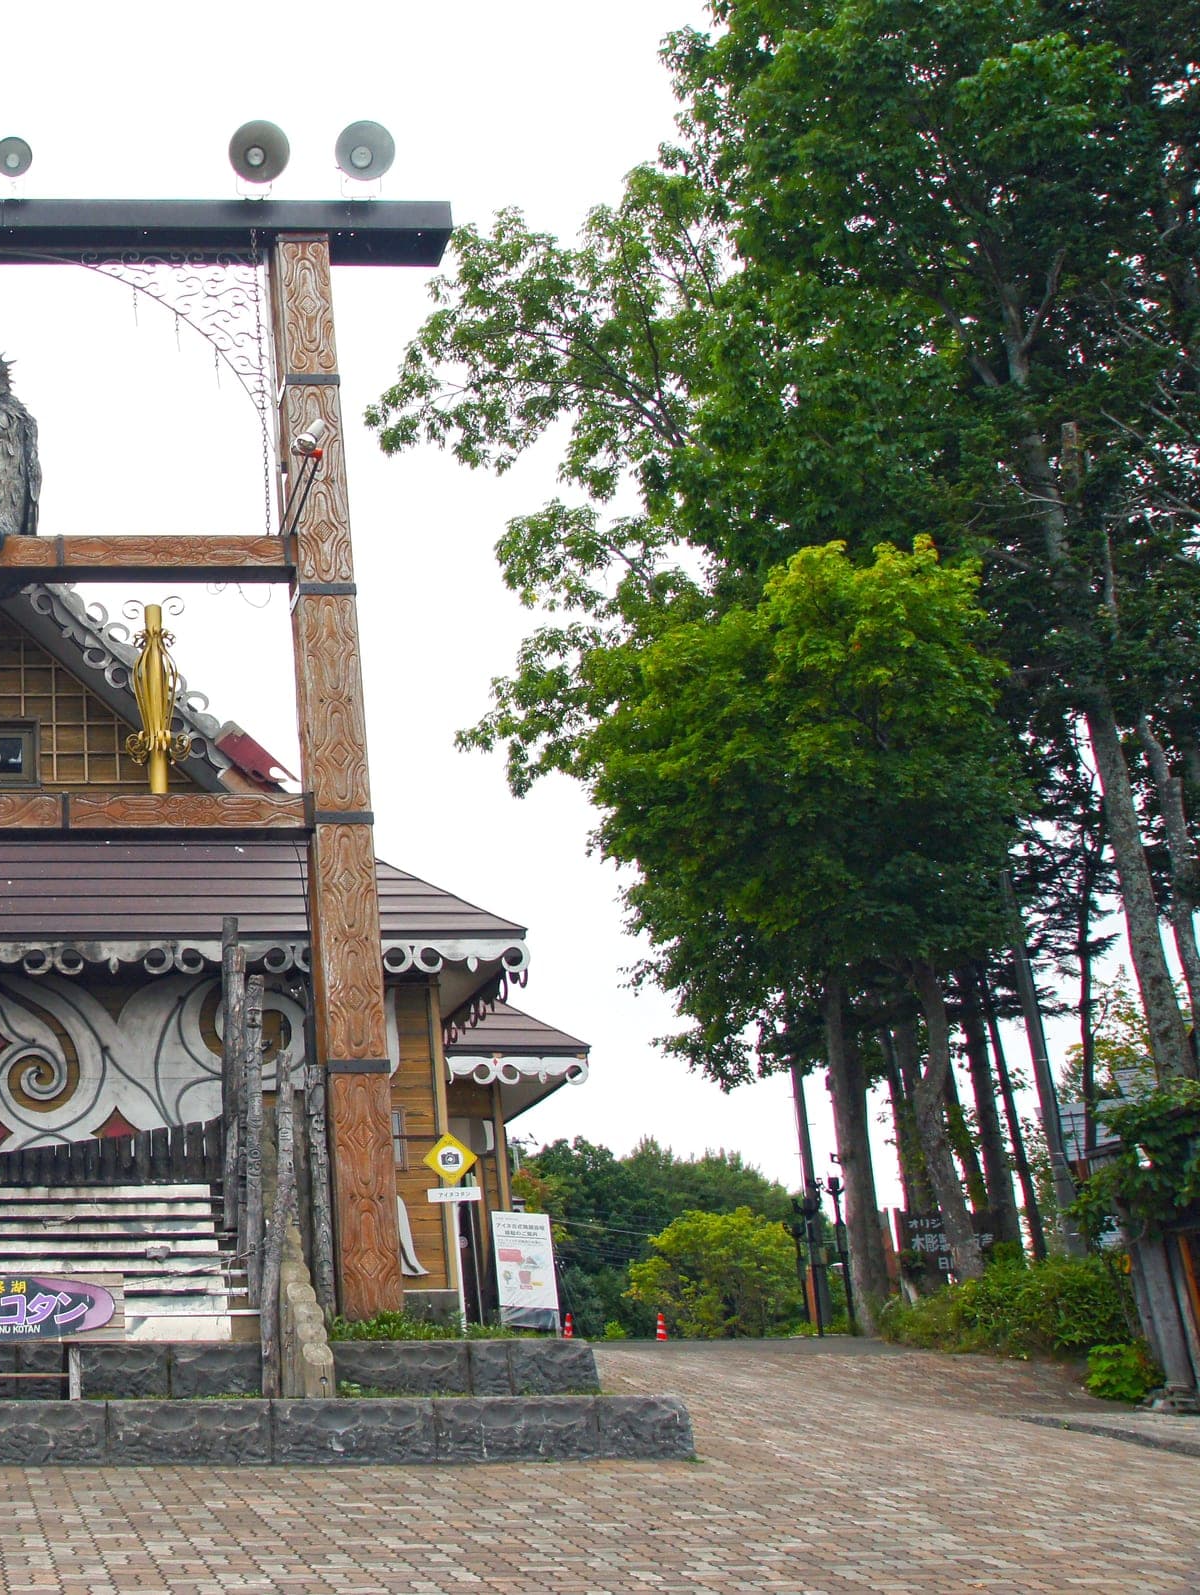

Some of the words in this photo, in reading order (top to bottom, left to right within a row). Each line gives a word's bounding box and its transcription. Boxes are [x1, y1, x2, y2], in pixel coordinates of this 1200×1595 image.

[907, 1218, 944, 1229] オリジ
[12, 1325, 41, 1334] KOTAN
